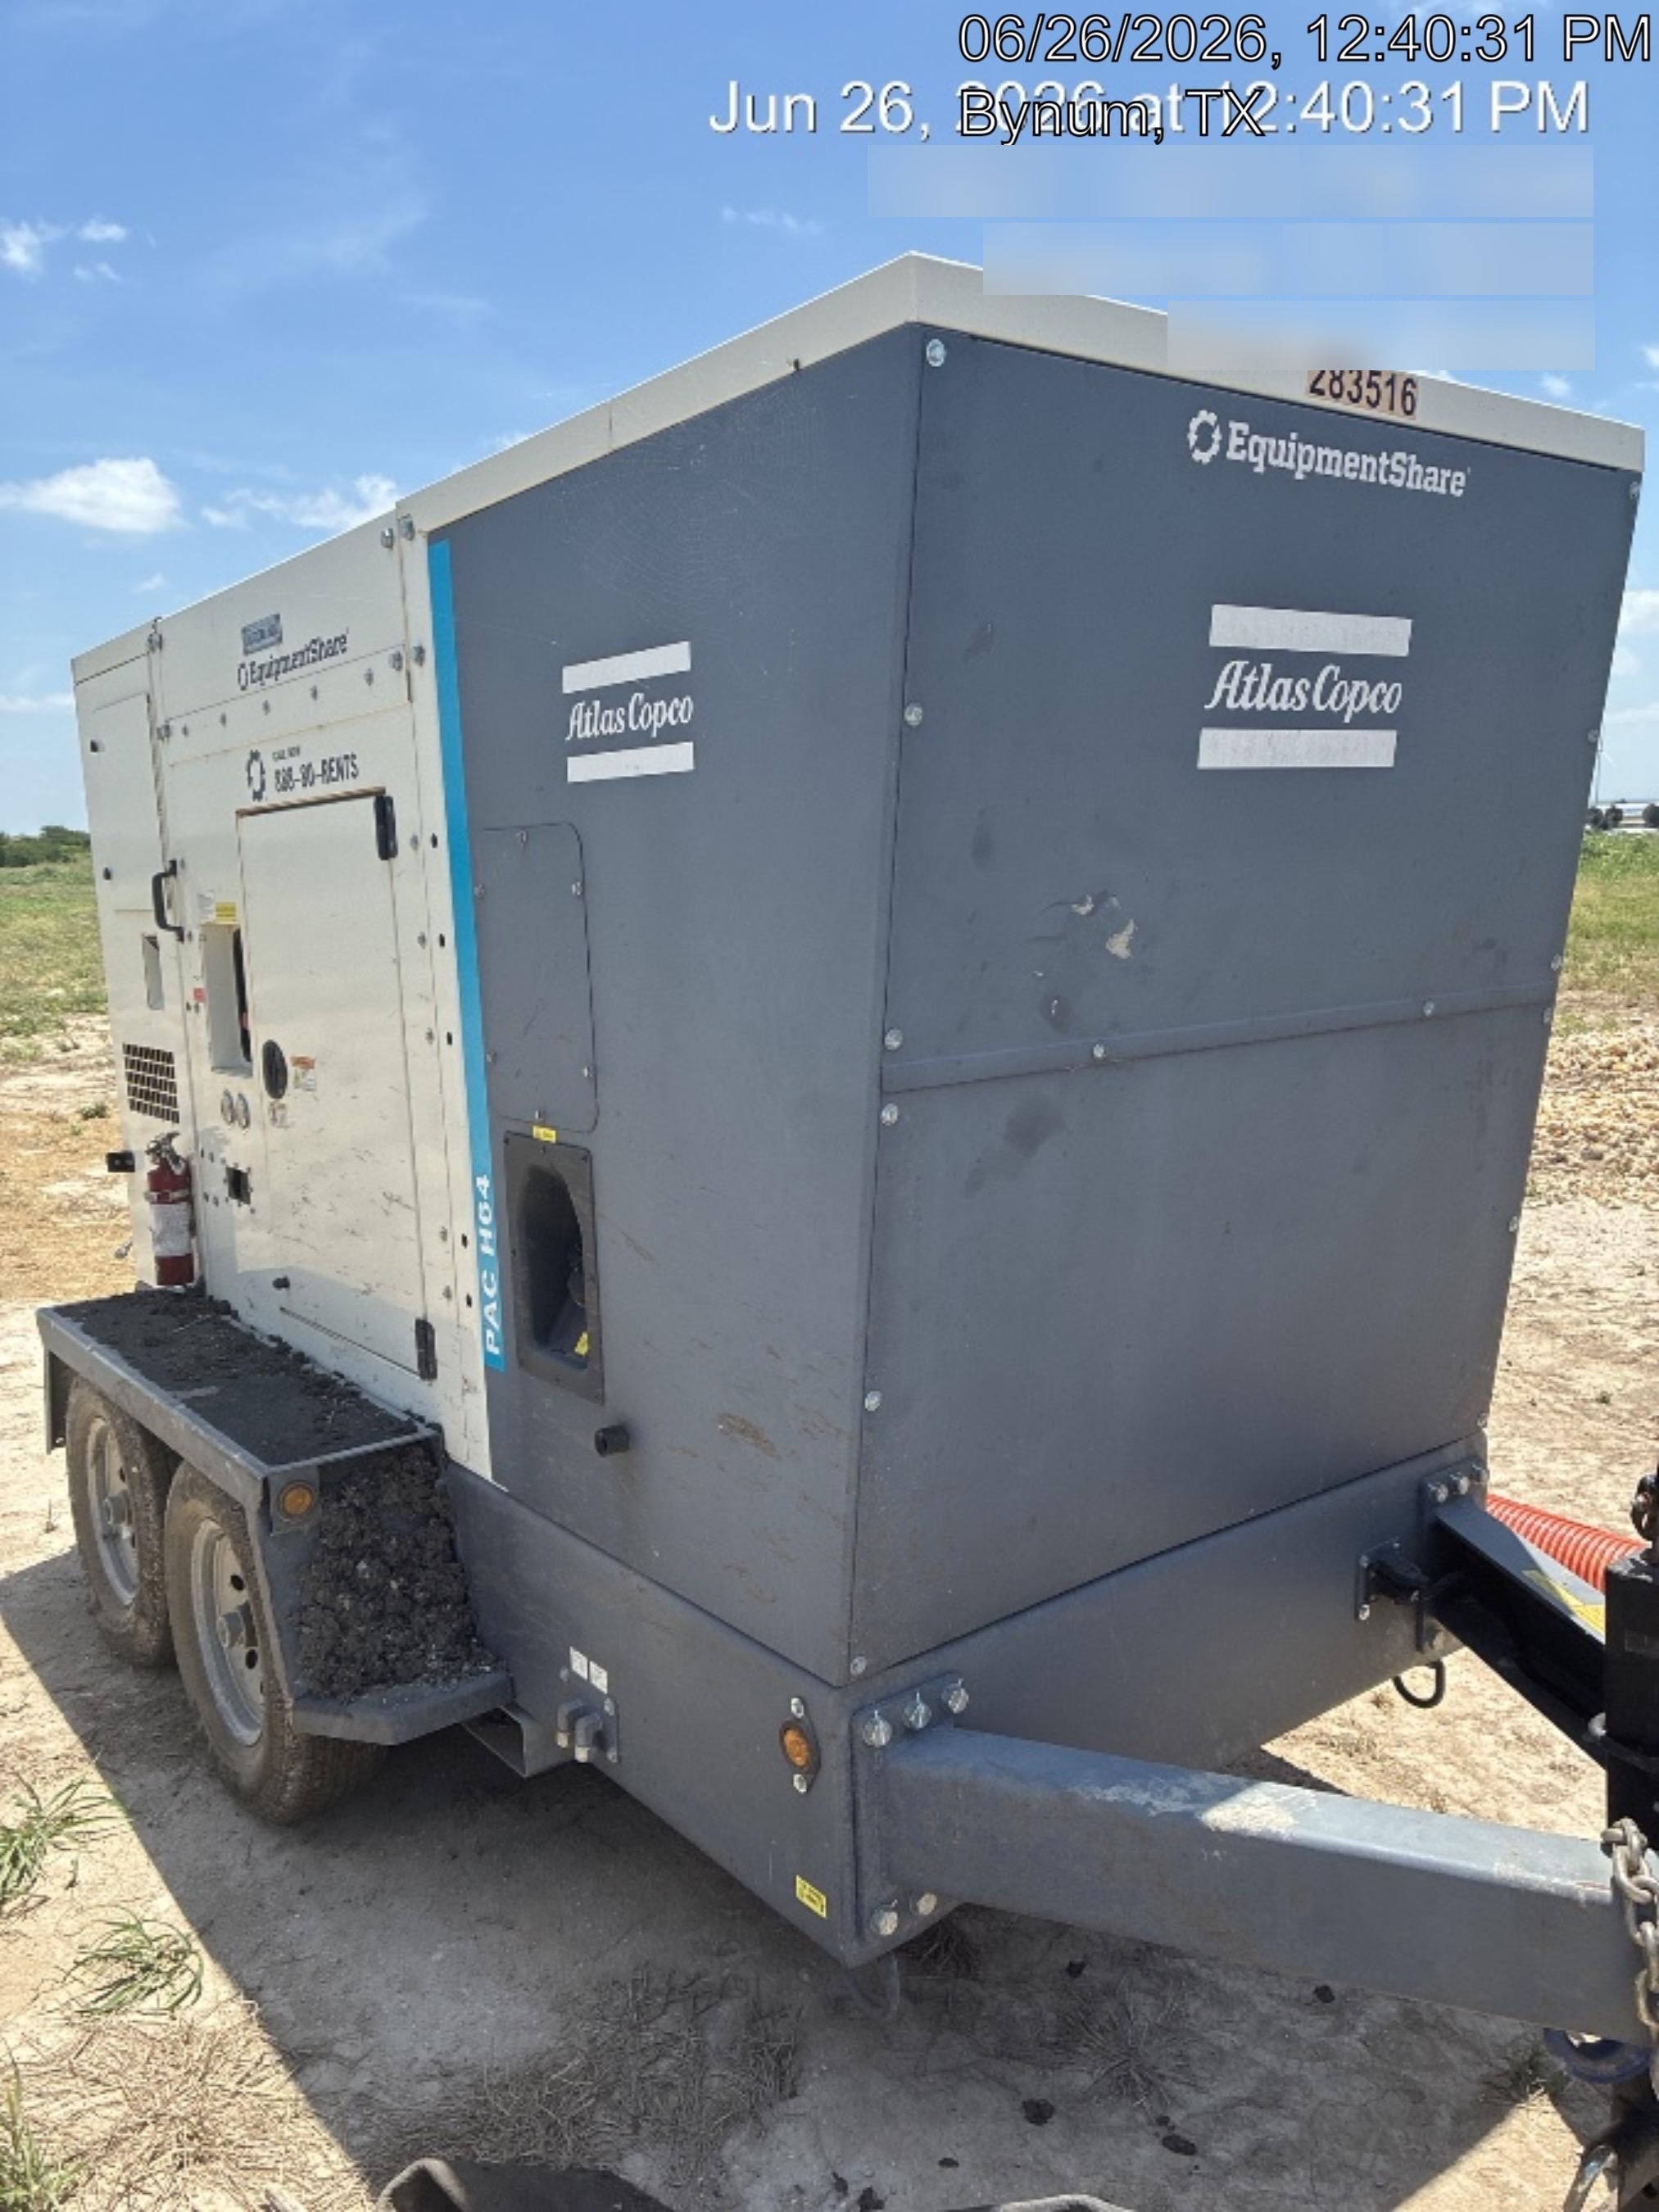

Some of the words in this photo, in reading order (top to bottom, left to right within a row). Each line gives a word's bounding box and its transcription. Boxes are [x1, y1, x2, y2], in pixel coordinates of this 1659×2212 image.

[1309, 370, 1417, 416] 283516
[1226, 420, 1467, 497] EquipmentShare
[250, 633, 347, 687] EquipmentShare
[1204, 660, 1311, 711] Atlas
[1312, 664, 1403, 723] Copco
[565, 700, 625, 741] Atlas
[628, 692, 694, 738] Copco
[476, 1174, 495, 1257] H64
[482, 1270, 500, 1355] PAC
